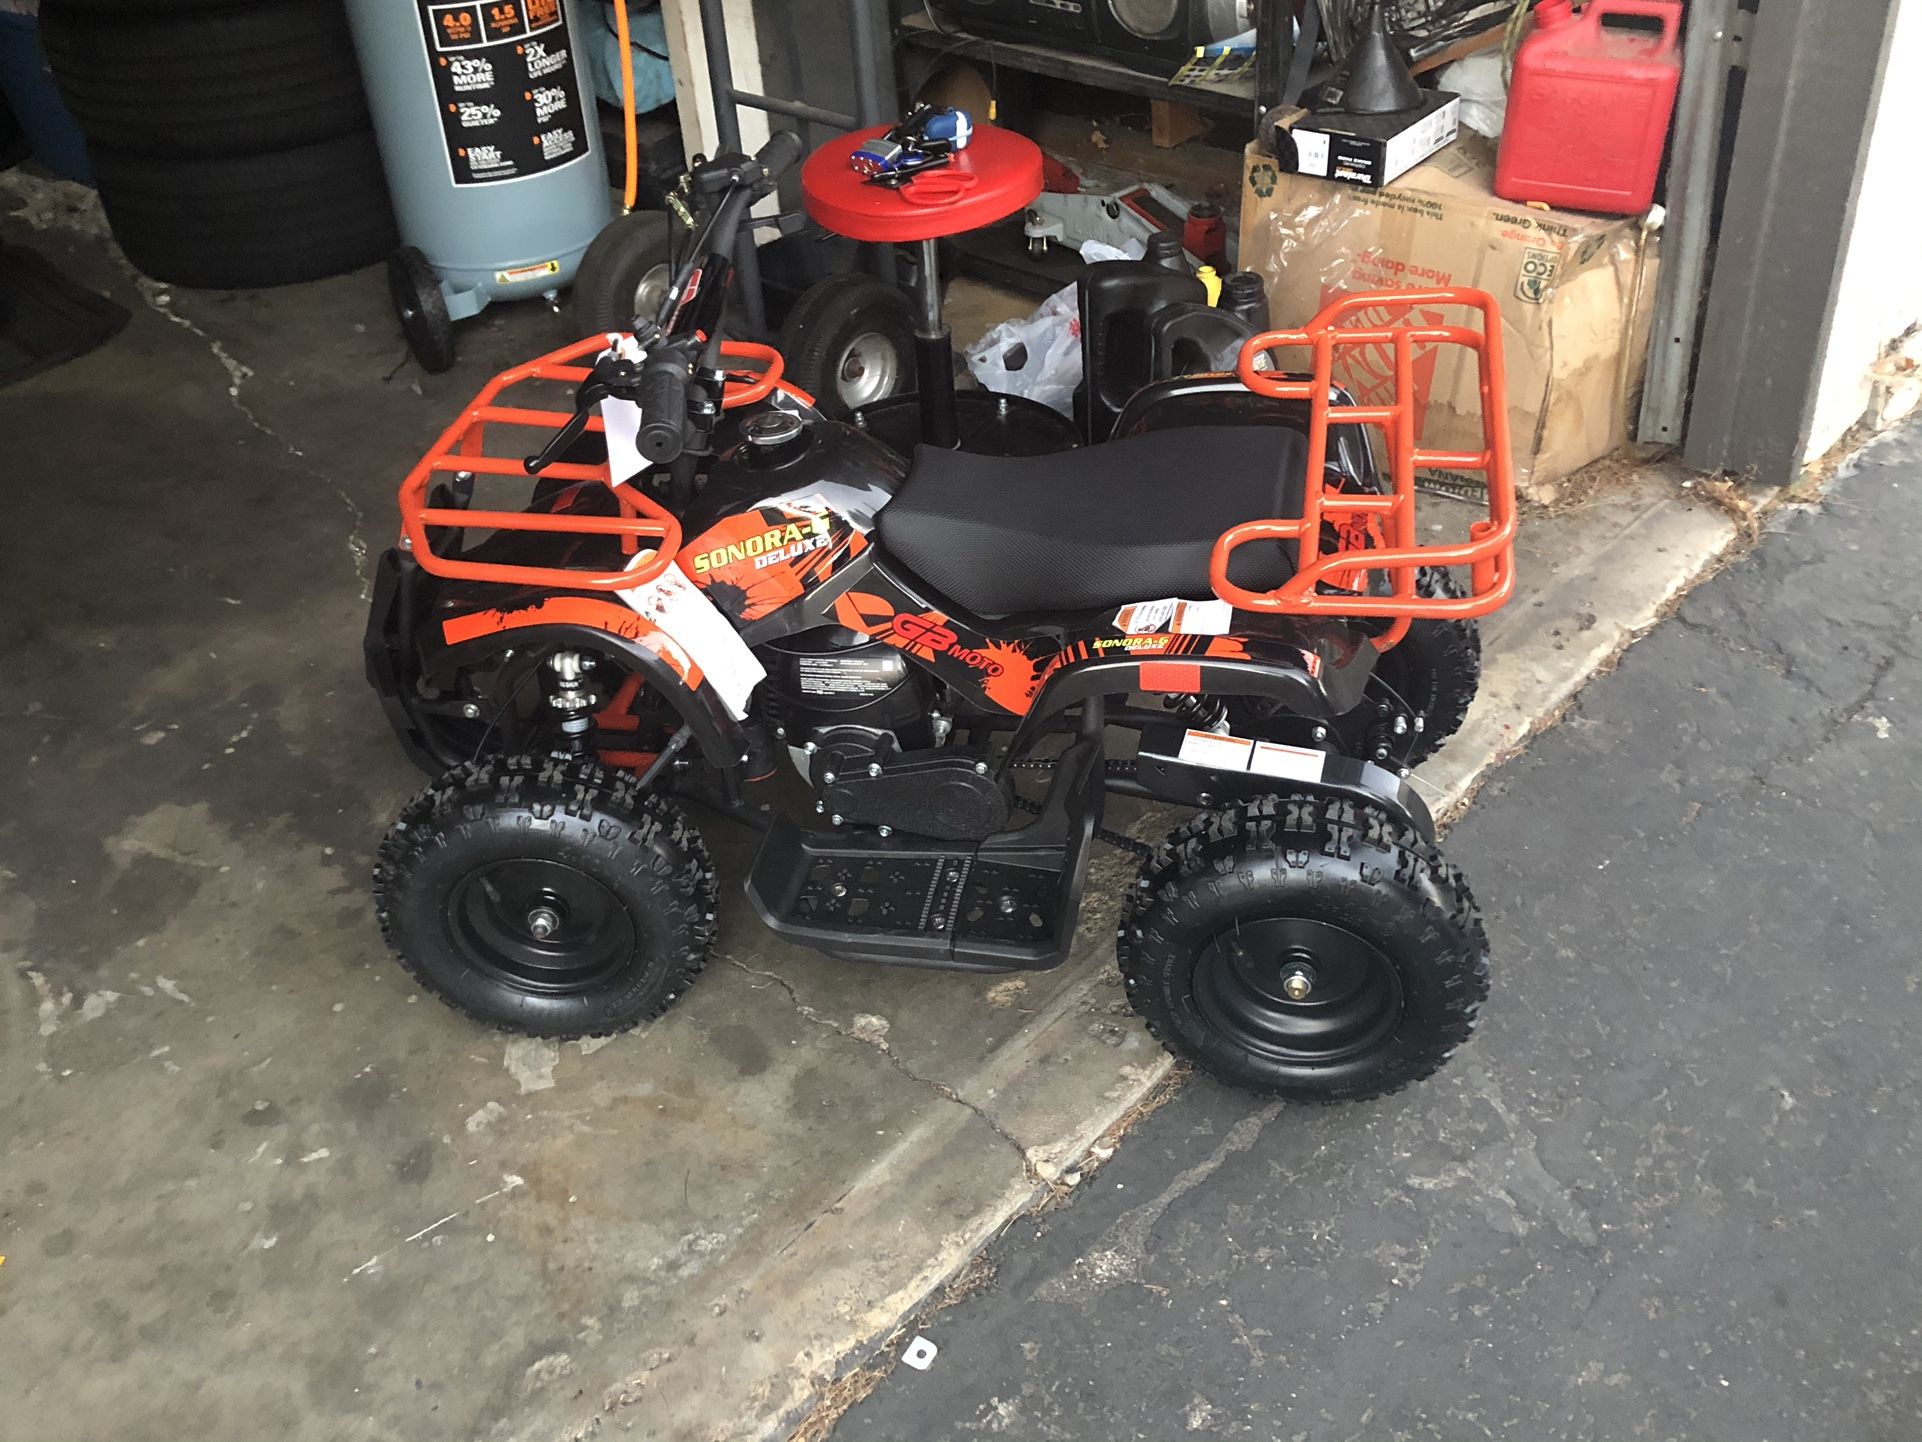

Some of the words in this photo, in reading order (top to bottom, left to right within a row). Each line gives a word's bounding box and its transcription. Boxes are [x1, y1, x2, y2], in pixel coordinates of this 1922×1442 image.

[443, 12, 472, 27] 4.0
[525, 44, 547, 62] 2X
[527, 49, 568, 72] LONGER
[450, 58, 493, 75] 43%
[453, 71, 495, 85] MORE
[533, 86, 566, 107] 30%
[459, 104, 502, 121] 25%
[536, 98, 567, 117] MORE
[1370, 201, 1395, 213] made
[1396, 204, 1406, 214] is
[1417, 197, 1442, 211] 100%
[1426, 208, 1443, 221] This
[1492, 211, 1531, 230] Green.
[1534, 217, 1568, 238] Think
[1409, 266, 1452, 288] More
[1523, 260, 1555, 277] ECO
[754, 535, 830, 570] DELUXE
[892, 612, 959, 653] GB
[947, 645, 1005, 679] MOTO
[1124, 643, 1165, 651] DELUXE
